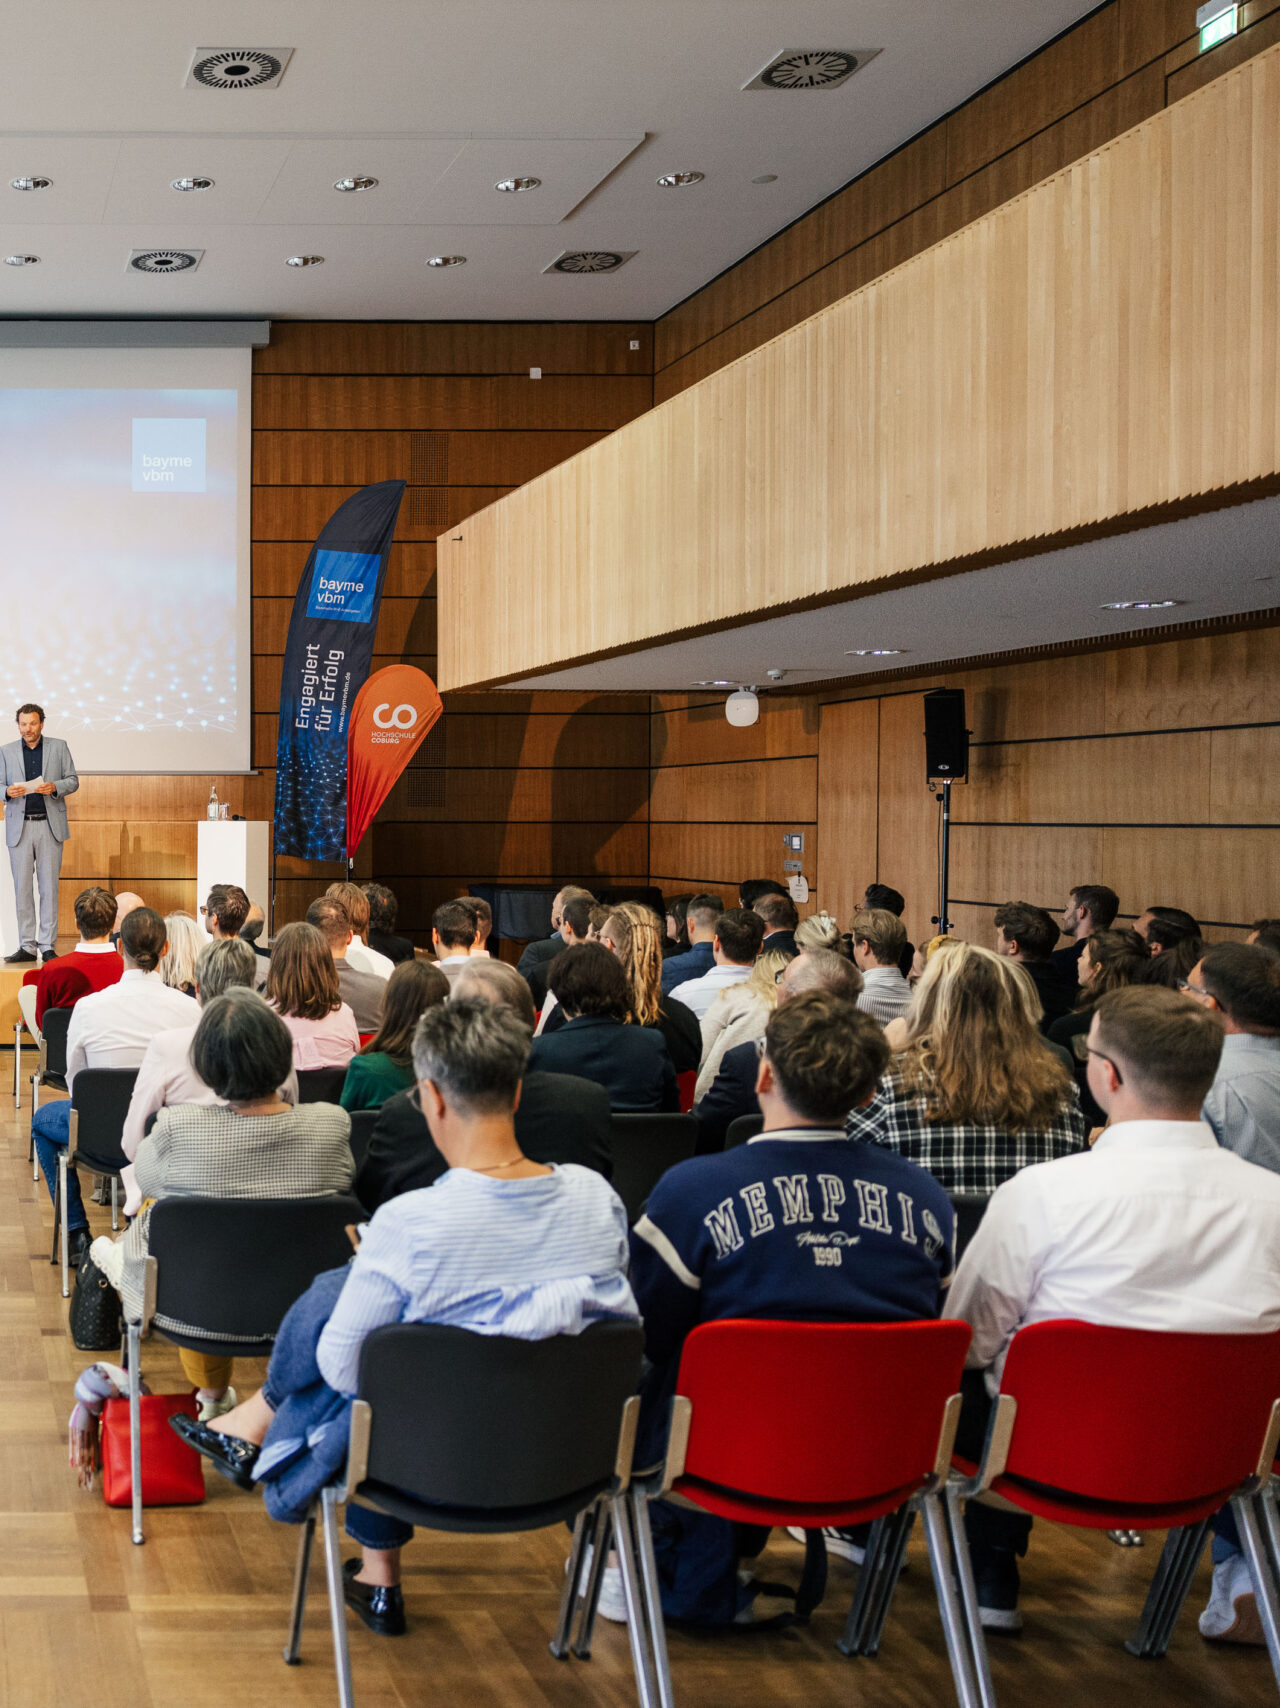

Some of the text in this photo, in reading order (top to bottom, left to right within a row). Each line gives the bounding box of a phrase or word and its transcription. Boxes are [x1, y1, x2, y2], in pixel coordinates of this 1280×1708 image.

[143, 454, 193, 470] bayme
[142, 469, 175, 482] vbm
[320, 576, 364, 593] bayme
[317, 590, 345, 605] vbm
[295, 643, 321, 729] Engagiert
[314, 649, 345, 731] für Erfolg
[371, 731, 417, 739] HOCHSCHULE
[703, 1174, 945, 1260] MEMPHIS
[812, 1247, 843, 1267] 1990
